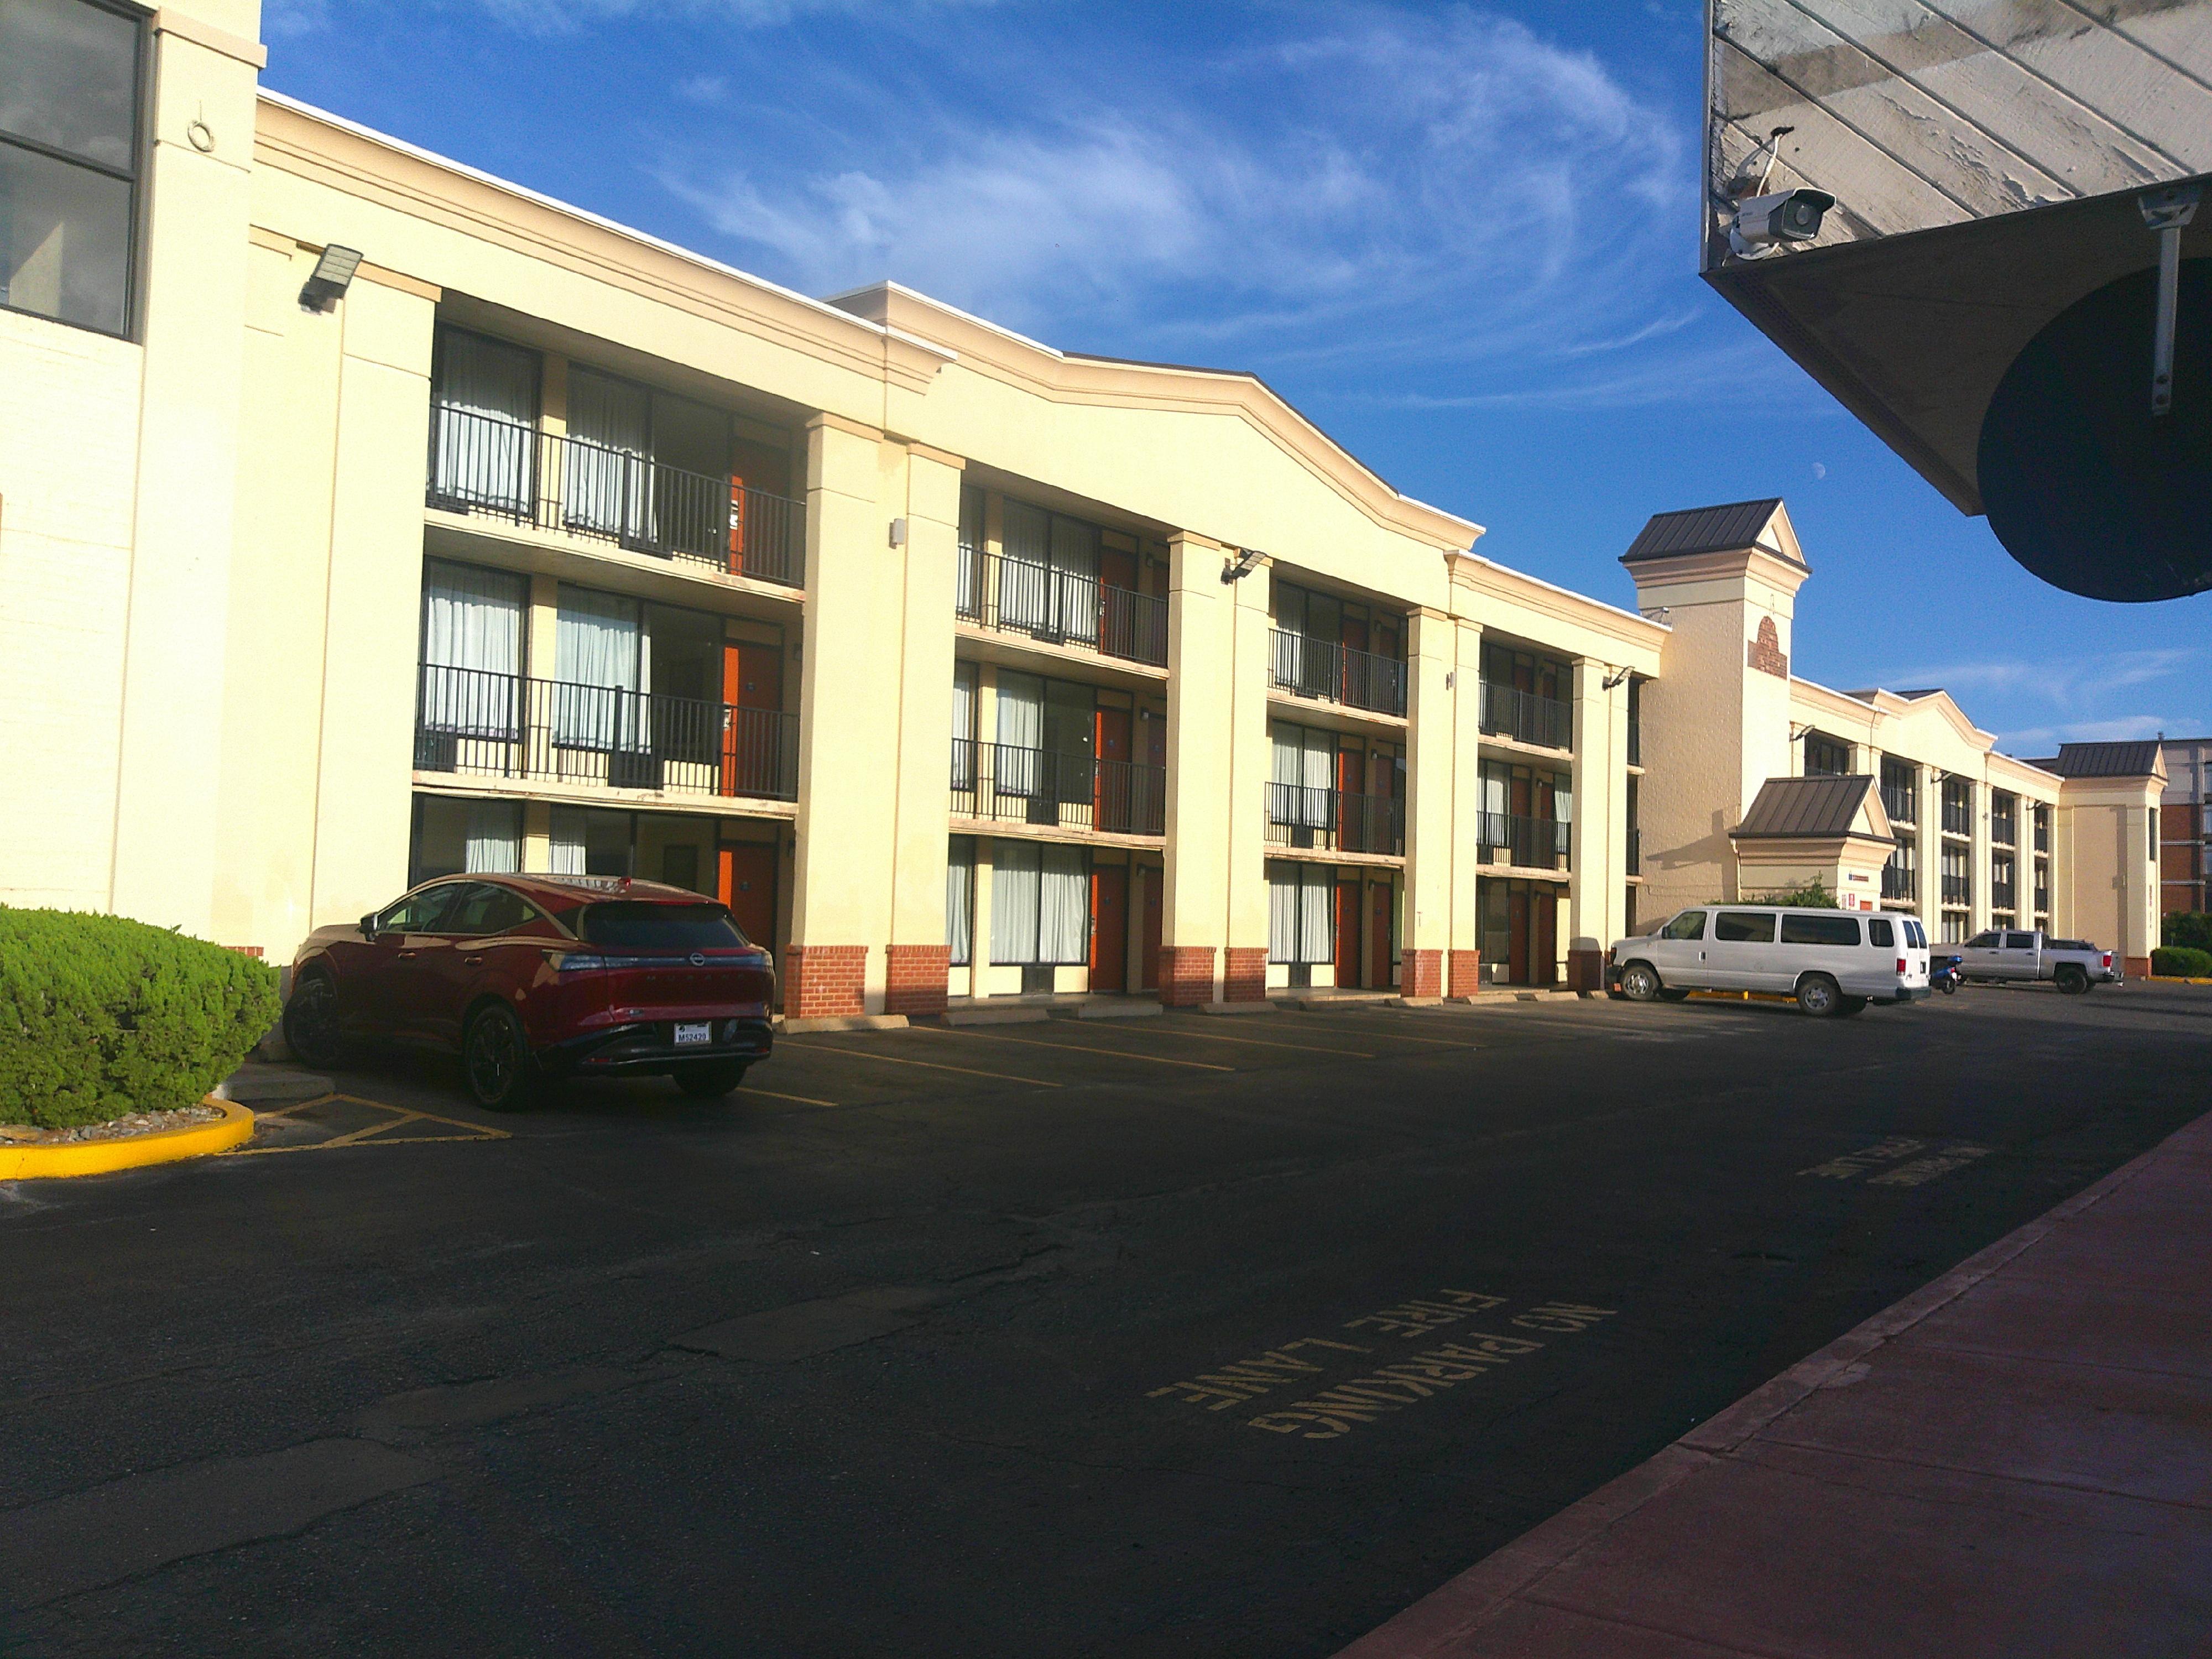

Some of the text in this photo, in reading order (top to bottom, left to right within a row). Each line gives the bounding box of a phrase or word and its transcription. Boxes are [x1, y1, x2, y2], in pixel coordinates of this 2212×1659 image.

[1143, 1289, 1509, 1411] FIRE LANE
[1248, 1302, 1618, 1438] NO PARKING
